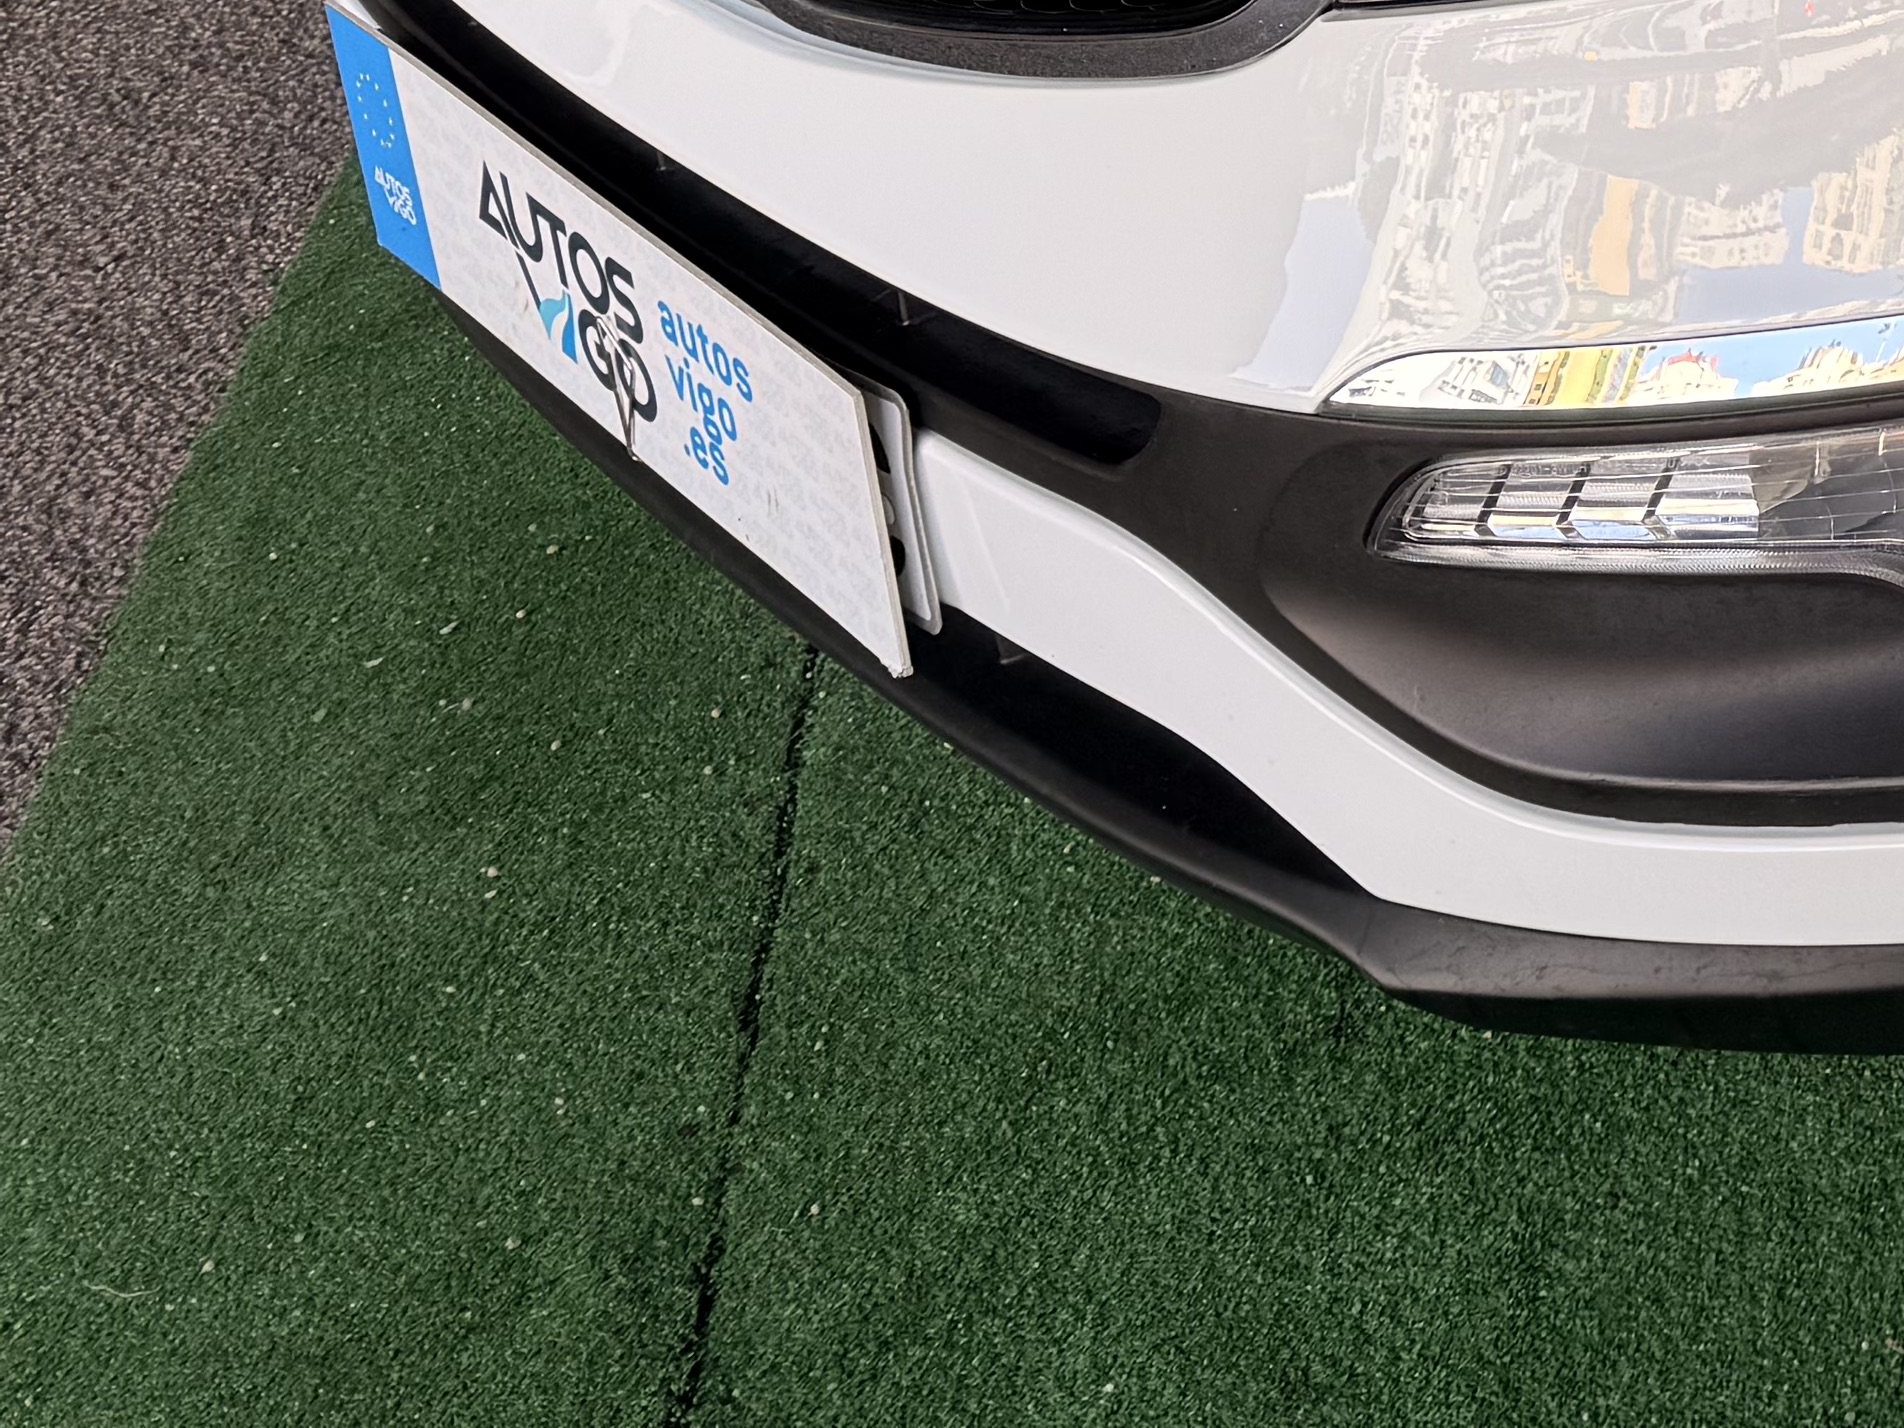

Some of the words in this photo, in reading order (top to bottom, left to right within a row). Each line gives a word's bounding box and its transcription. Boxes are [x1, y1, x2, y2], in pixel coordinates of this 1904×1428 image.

[375, 165, 412, 206] AUTOS
[479, 160, 643, 344] AUTOS
[515, 251, 657, 422] VIGO
[657, 300, 752, 403] autos
[665, 354, 737, 445] vigo
[684, 427, 729, 486] .es
